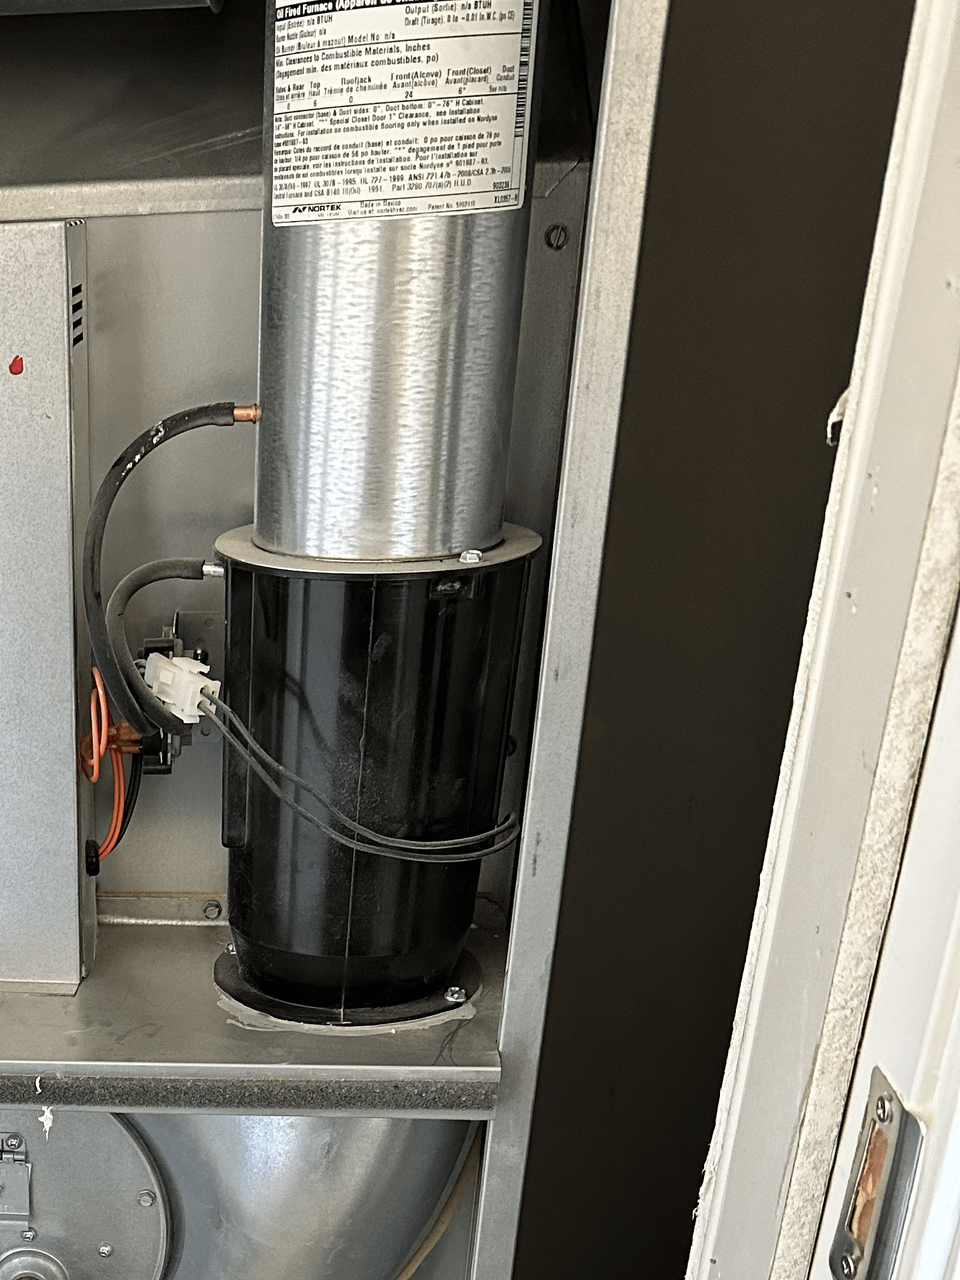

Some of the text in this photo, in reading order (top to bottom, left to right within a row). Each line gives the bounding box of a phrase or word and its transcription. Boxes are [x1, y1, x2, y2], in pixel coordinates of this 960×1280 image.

[321, 48, 363, 61] Combustible
[404, 42, 431, 53] Inches
[320, 63, 332, 73] des
[425, 52, 440, 65] po)
[309, 80, 321, 90] Top
[404, 90, 413, 99] 24
[329, 114, 387, 127] Special Closet Door
[364, 140, 384, 149] (base)
[307, 203, 342, 213] NORTEK
